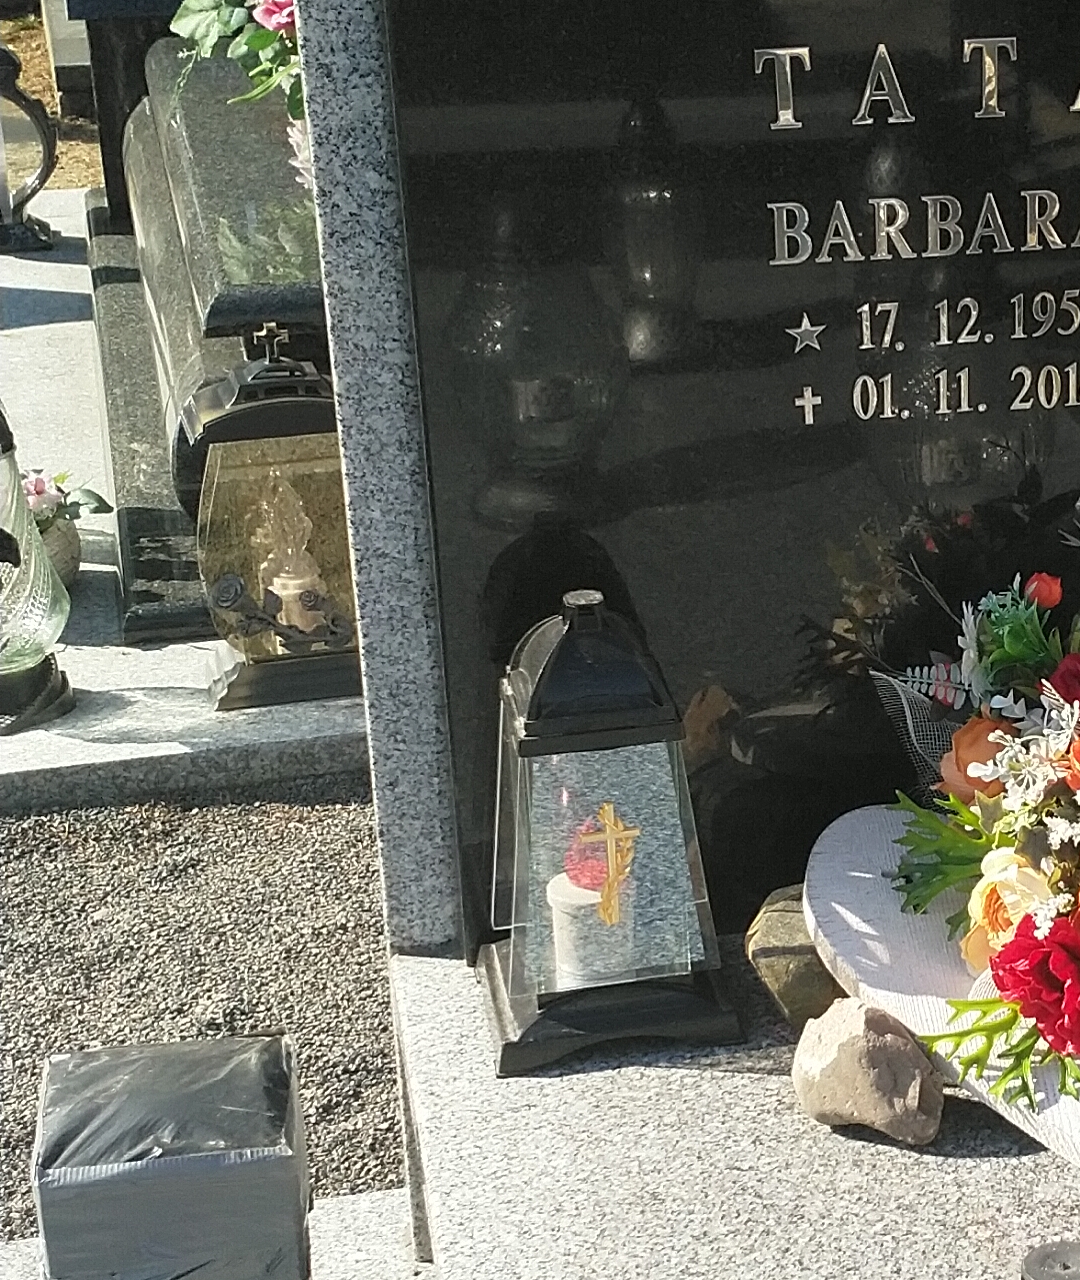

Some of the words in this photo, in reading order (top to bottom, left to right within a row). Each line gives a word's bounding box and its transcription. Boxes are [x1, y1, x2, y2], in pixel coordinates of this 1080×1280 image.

[856, 302, 905, 351] 17.
[934, 297, 994, 346] 12.
[853, 373, 910, 420] 01.
[934, 367, 987, 415] 11.
